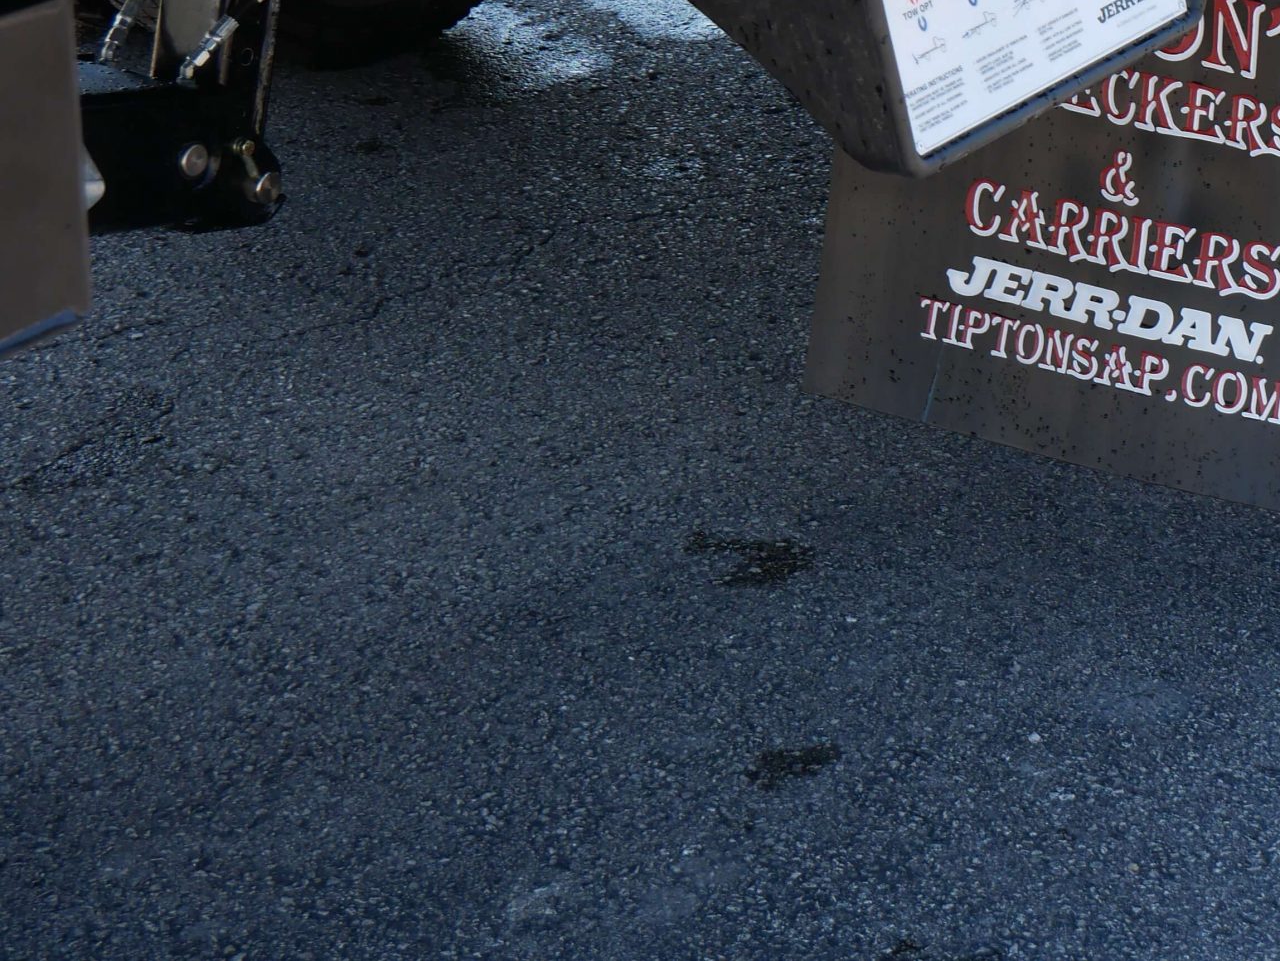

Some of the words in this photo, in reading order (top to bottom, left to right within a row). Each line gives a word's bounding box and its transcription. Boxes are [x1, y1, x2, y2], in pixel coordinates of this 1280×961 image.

[902, 7, 918, 21] TOW
[919, 0, 934, 13] OPT
[1101, 149, 1140, 206] &
